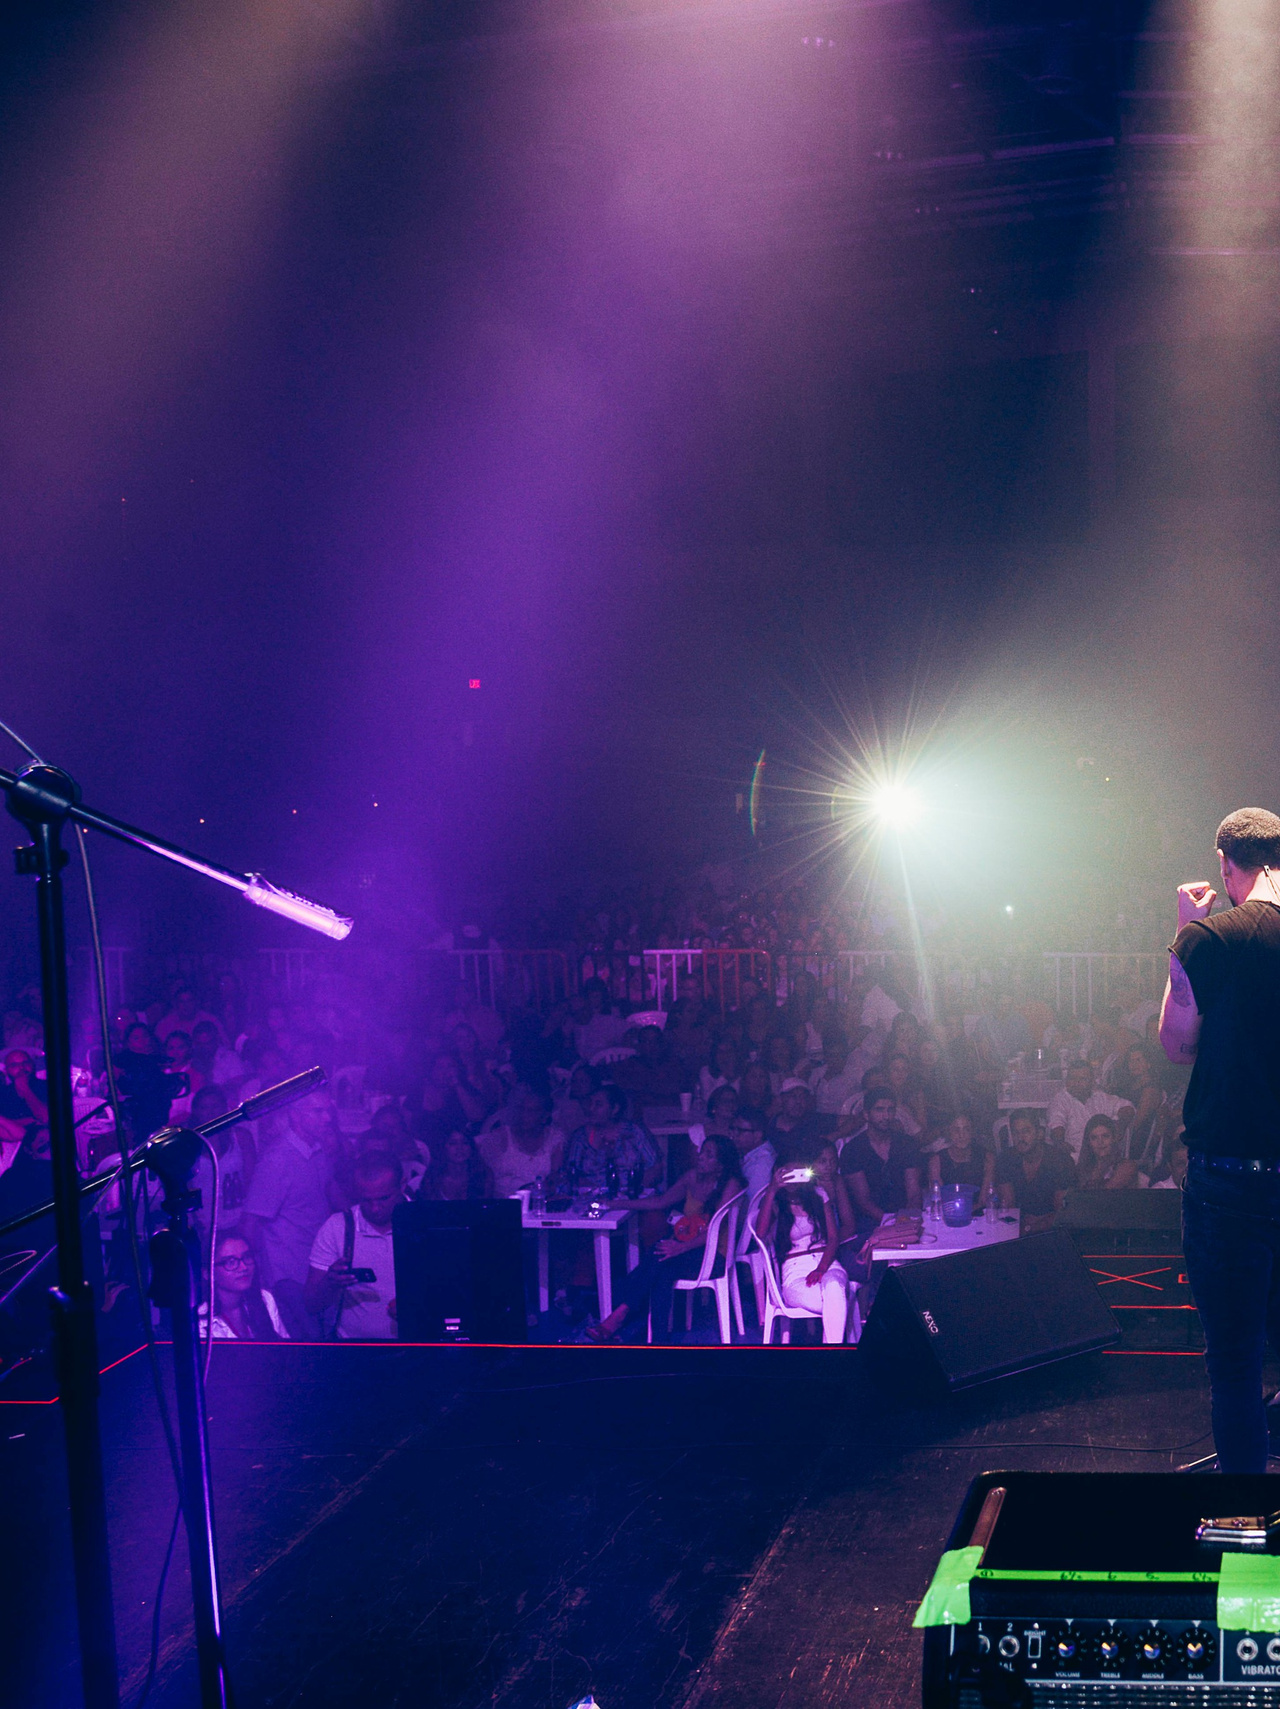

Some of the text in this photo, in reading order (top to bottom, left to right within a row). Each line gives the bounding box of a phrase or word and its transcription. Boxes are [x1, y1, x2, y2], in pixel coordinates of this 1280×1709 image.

[922, 1311, 939, 1334] NEXO
[1006, 1622, 1013, 1632] 2
[1055, 1671, 1081, 1679] VOLUME
[1187, 1672, 1204, 1680] BASS
